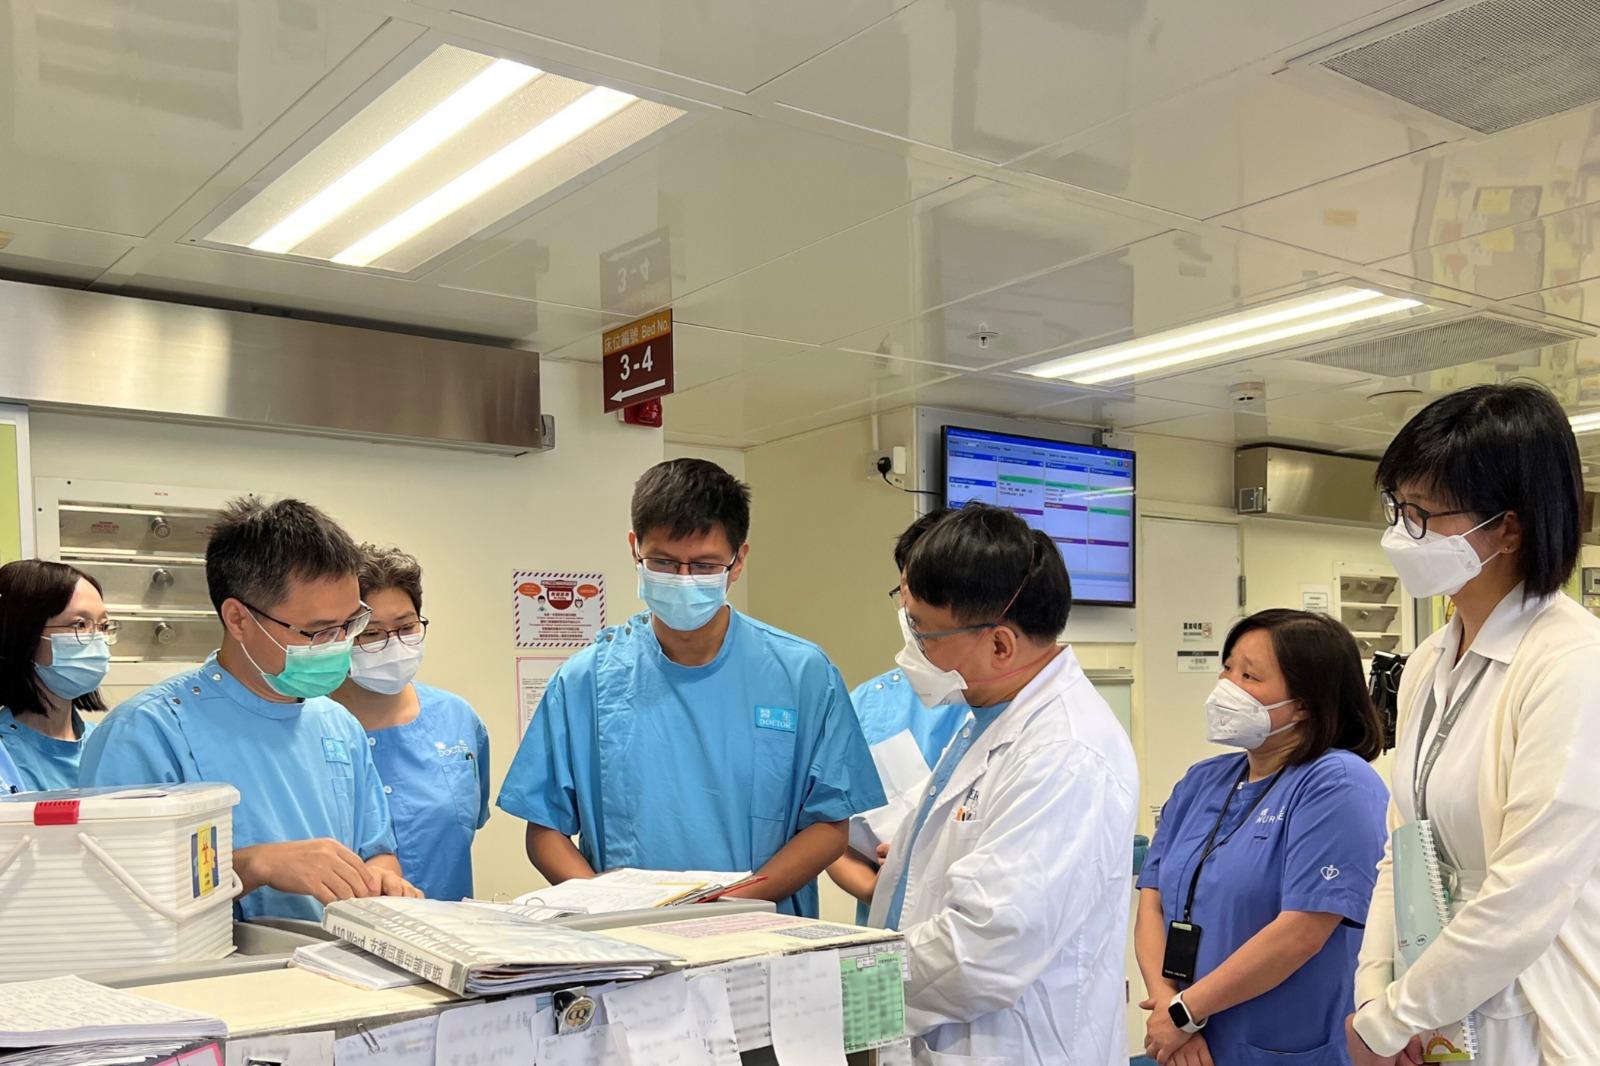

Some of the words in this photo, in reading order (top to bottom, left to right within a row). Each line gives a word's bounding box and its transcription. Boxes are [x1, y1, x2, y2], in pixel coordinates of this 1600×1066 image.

[641, 322, 656, 338] Bed
[657, 319, 671, 333] No.
[619, 345, 654, 381] 3-4
[759, 718, 792, 729] DOCTOR
[1255, 812, 1285, 824] NURE
[346, 929, 367, 952] Ward
